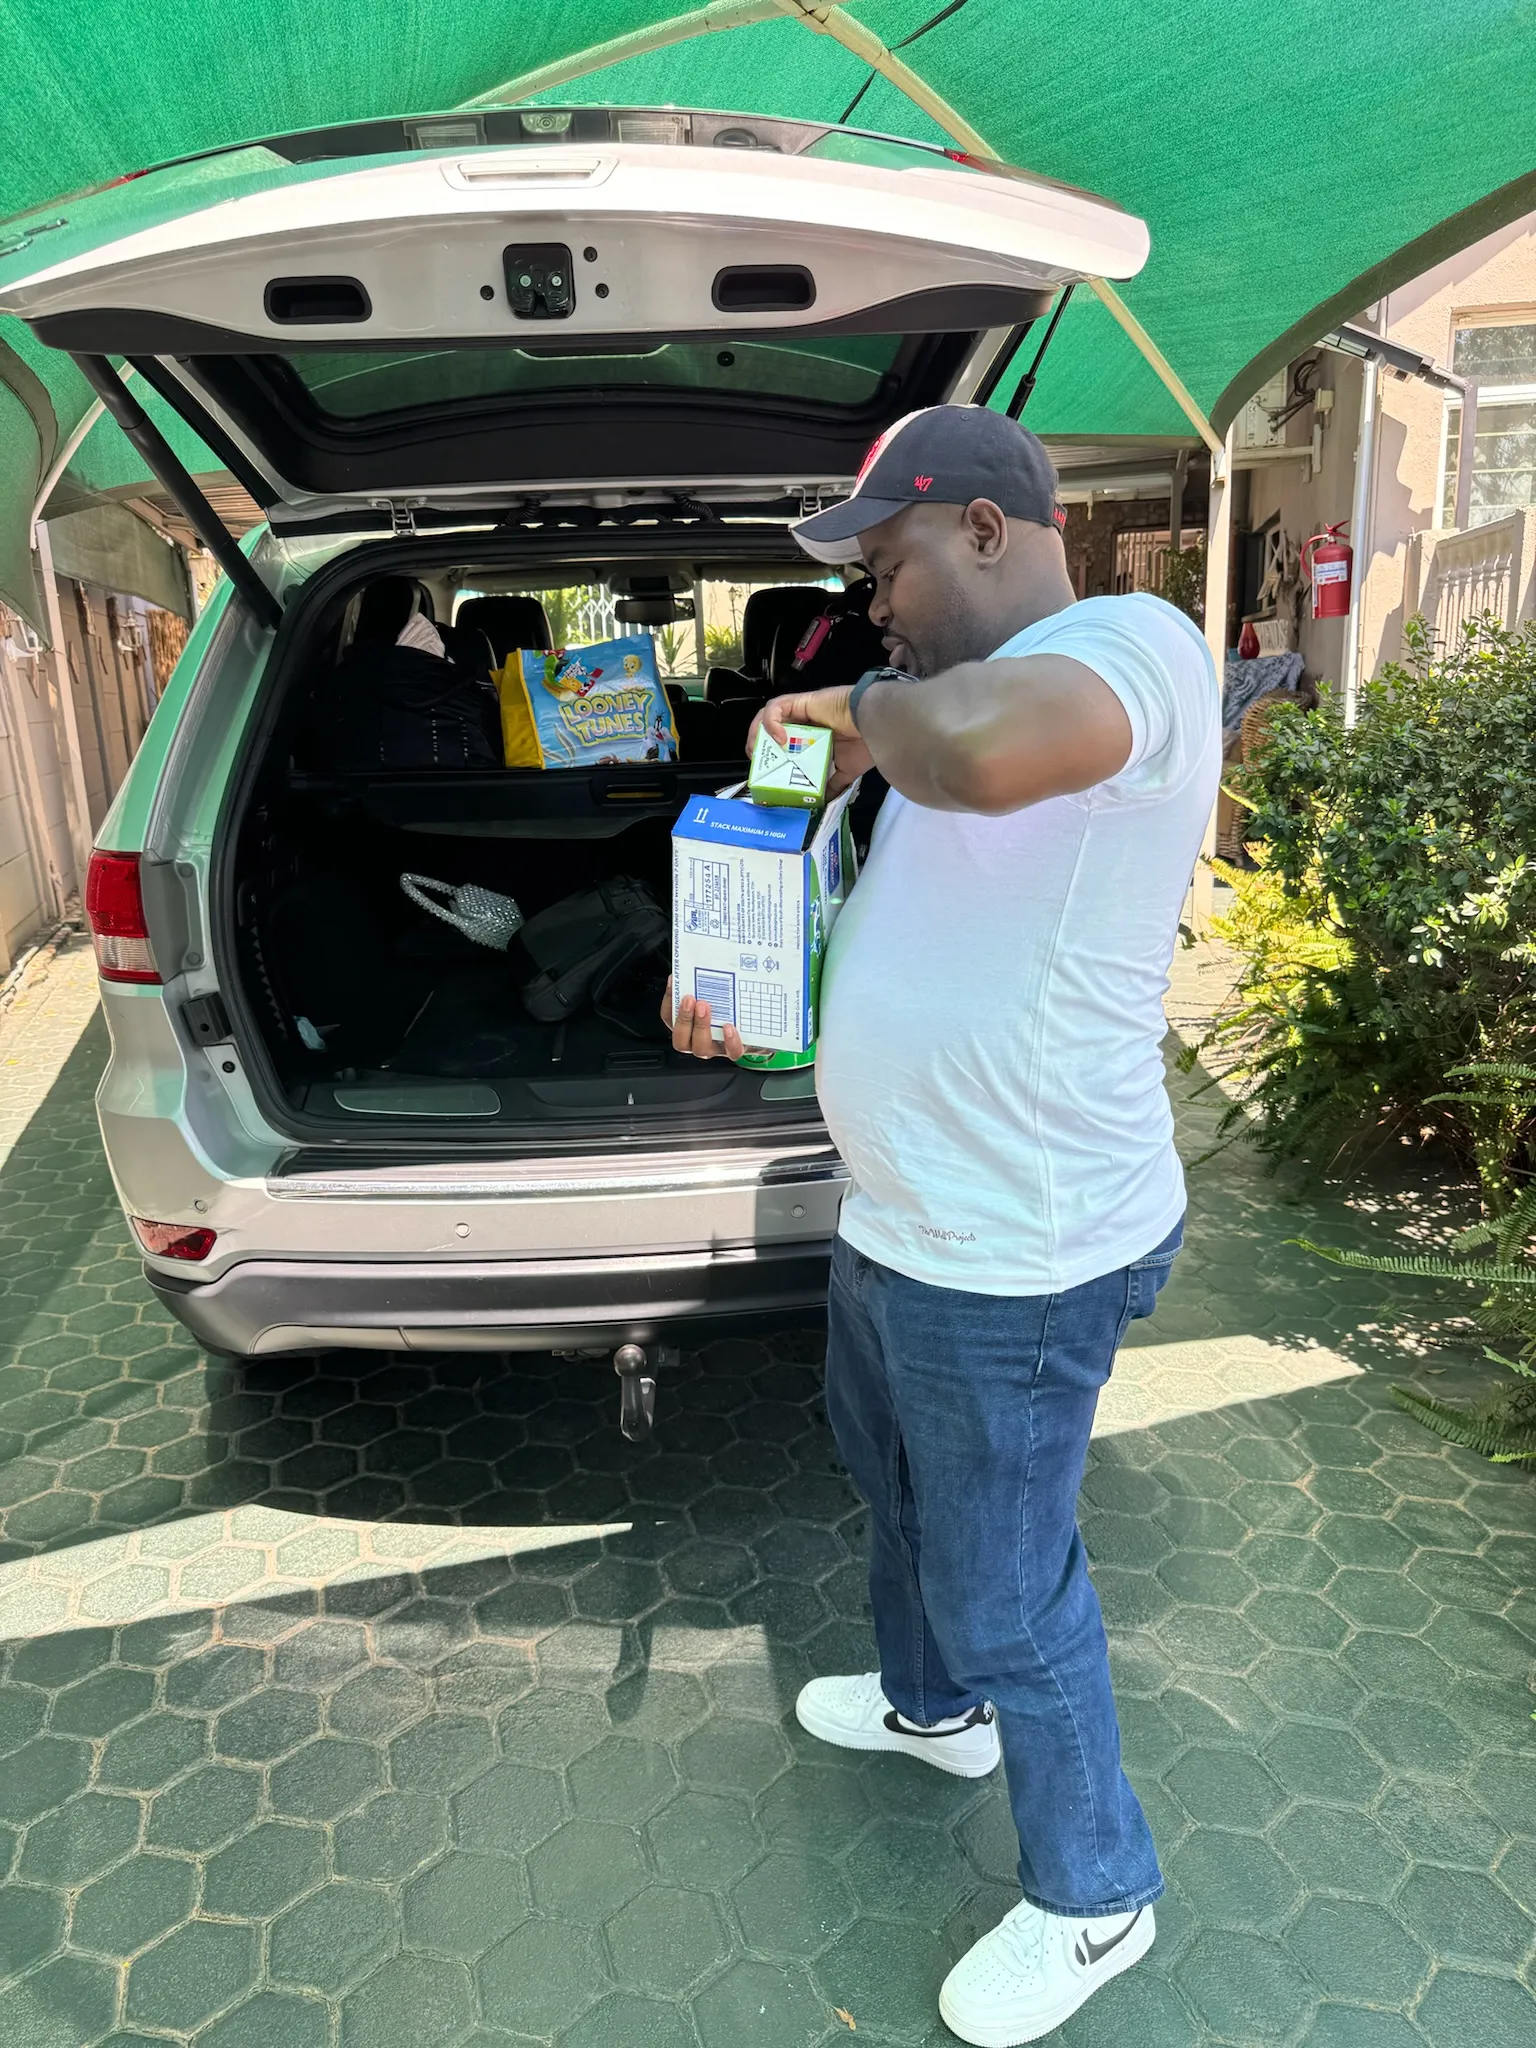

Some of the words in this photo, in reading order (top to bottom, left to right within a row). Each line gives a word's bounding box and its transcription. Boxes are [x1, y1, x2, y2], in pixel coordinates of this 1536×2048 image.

[563, 693, 648, 723] LOONEY
[578, 711, 645, 740] TUNES
[710, 821, 731, 831] STACK
[731, 825, 764, 836] MAXIMUM
[769, 831, 787, 839] HIGH
